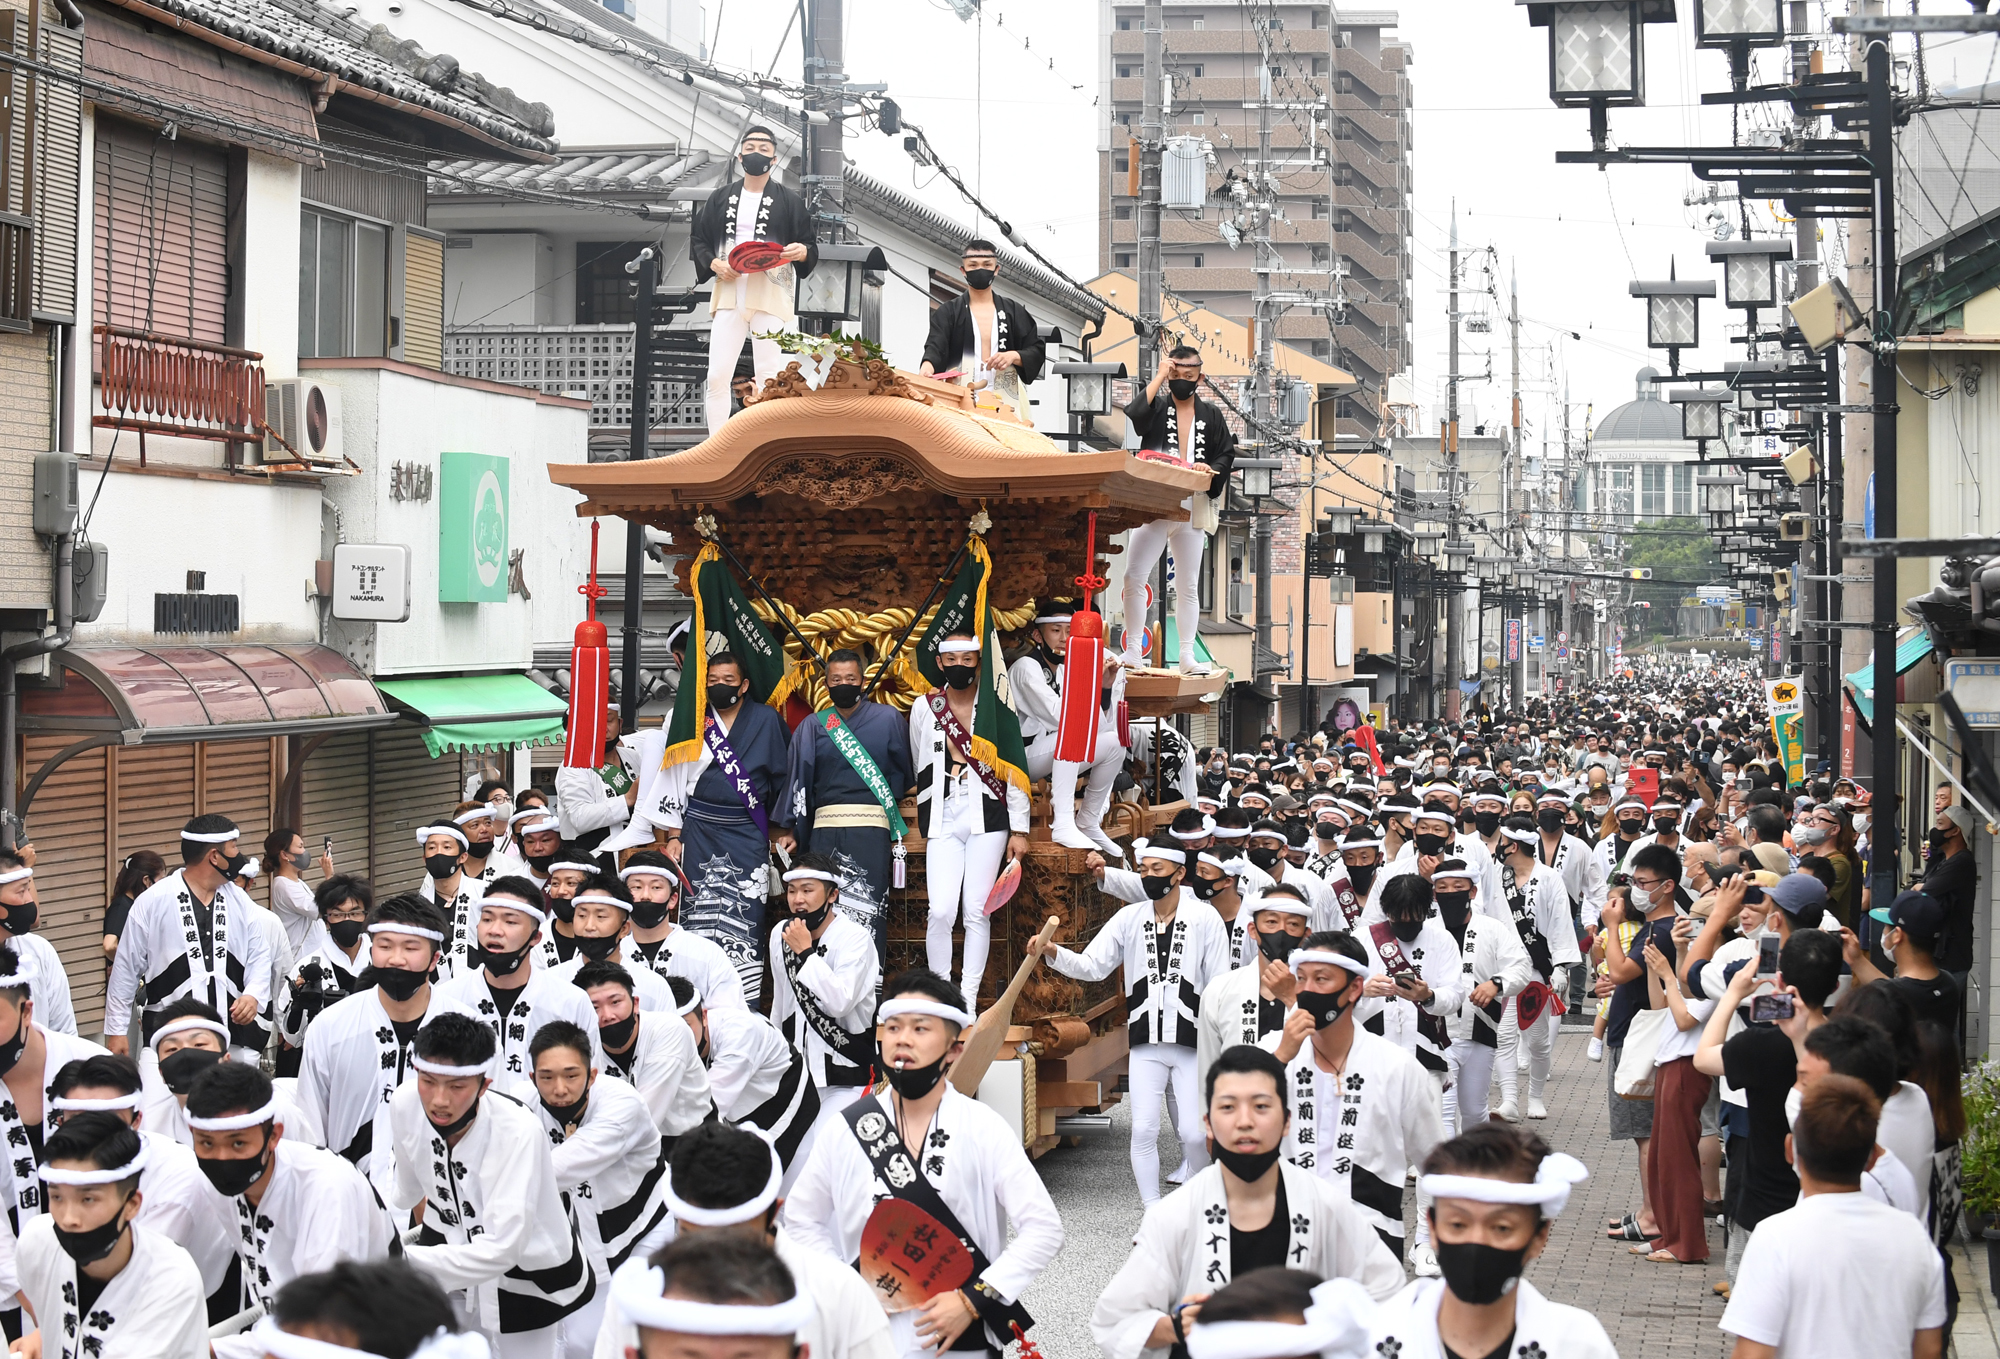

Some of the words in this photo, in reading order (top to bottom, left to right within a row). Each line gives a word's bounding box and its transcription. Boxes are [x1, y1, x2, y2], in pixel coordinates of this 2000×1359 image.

[154, 593, 239, 632] NAKAMURA
[1509, 621, 1518, 660] 本通り商店街
[1773, 703, 1799, 712] ヤマト運輸
[708, 729, 759, 810] 並松町会長
[507, 1022, 525, 1073] 綱元
[876, 1223, 939, 1298] 秋田一樹
